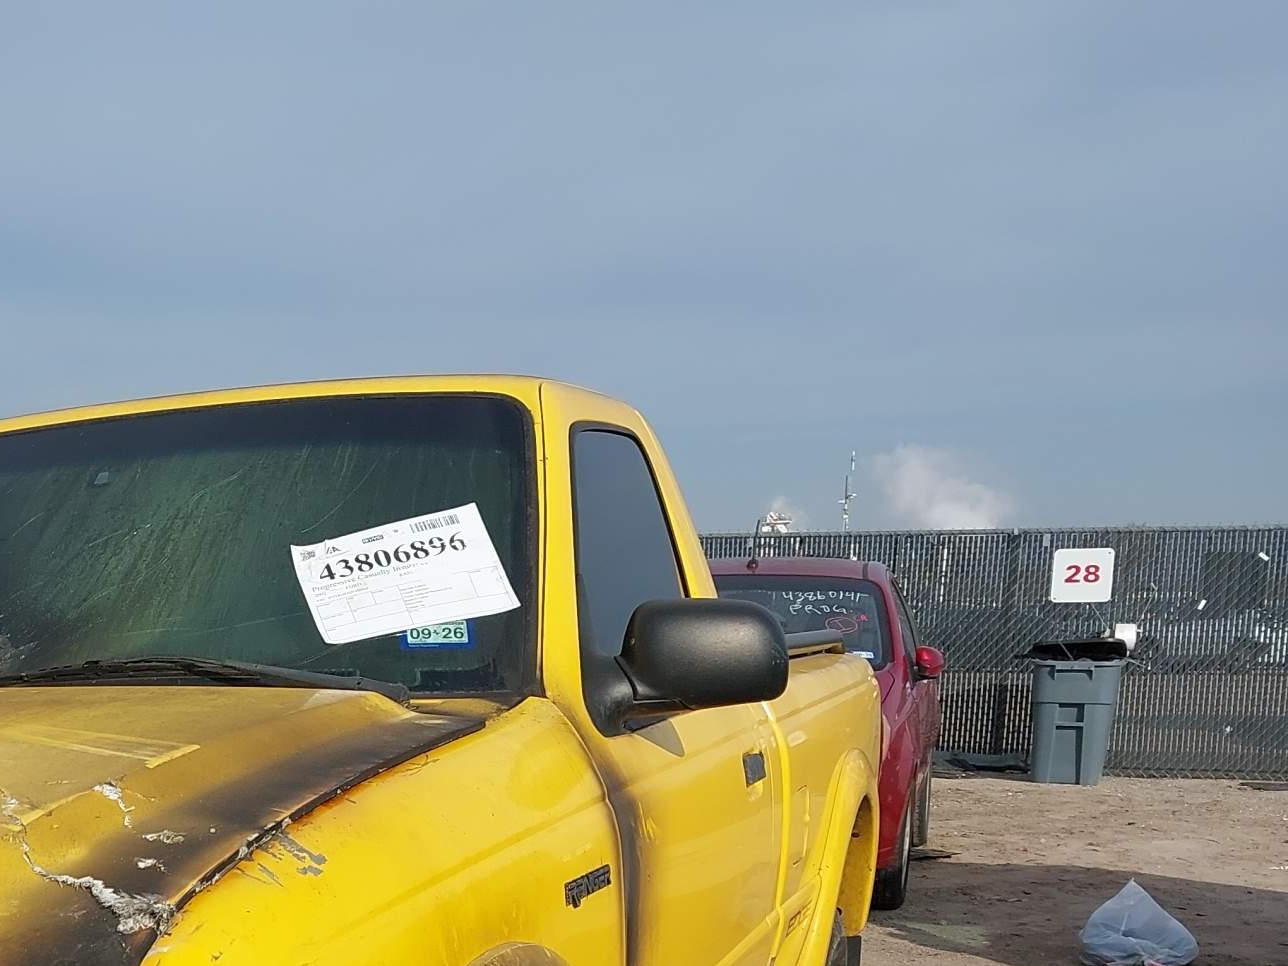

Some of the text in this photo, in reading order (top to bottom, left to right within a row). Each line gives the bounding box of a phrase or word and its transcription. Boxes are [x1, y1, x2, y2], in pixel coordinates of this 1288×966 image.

[319, 531, 467, 580] 43806896
[1064, 564, 1101, 583] 28
[442, 627, 465, 639] 26
